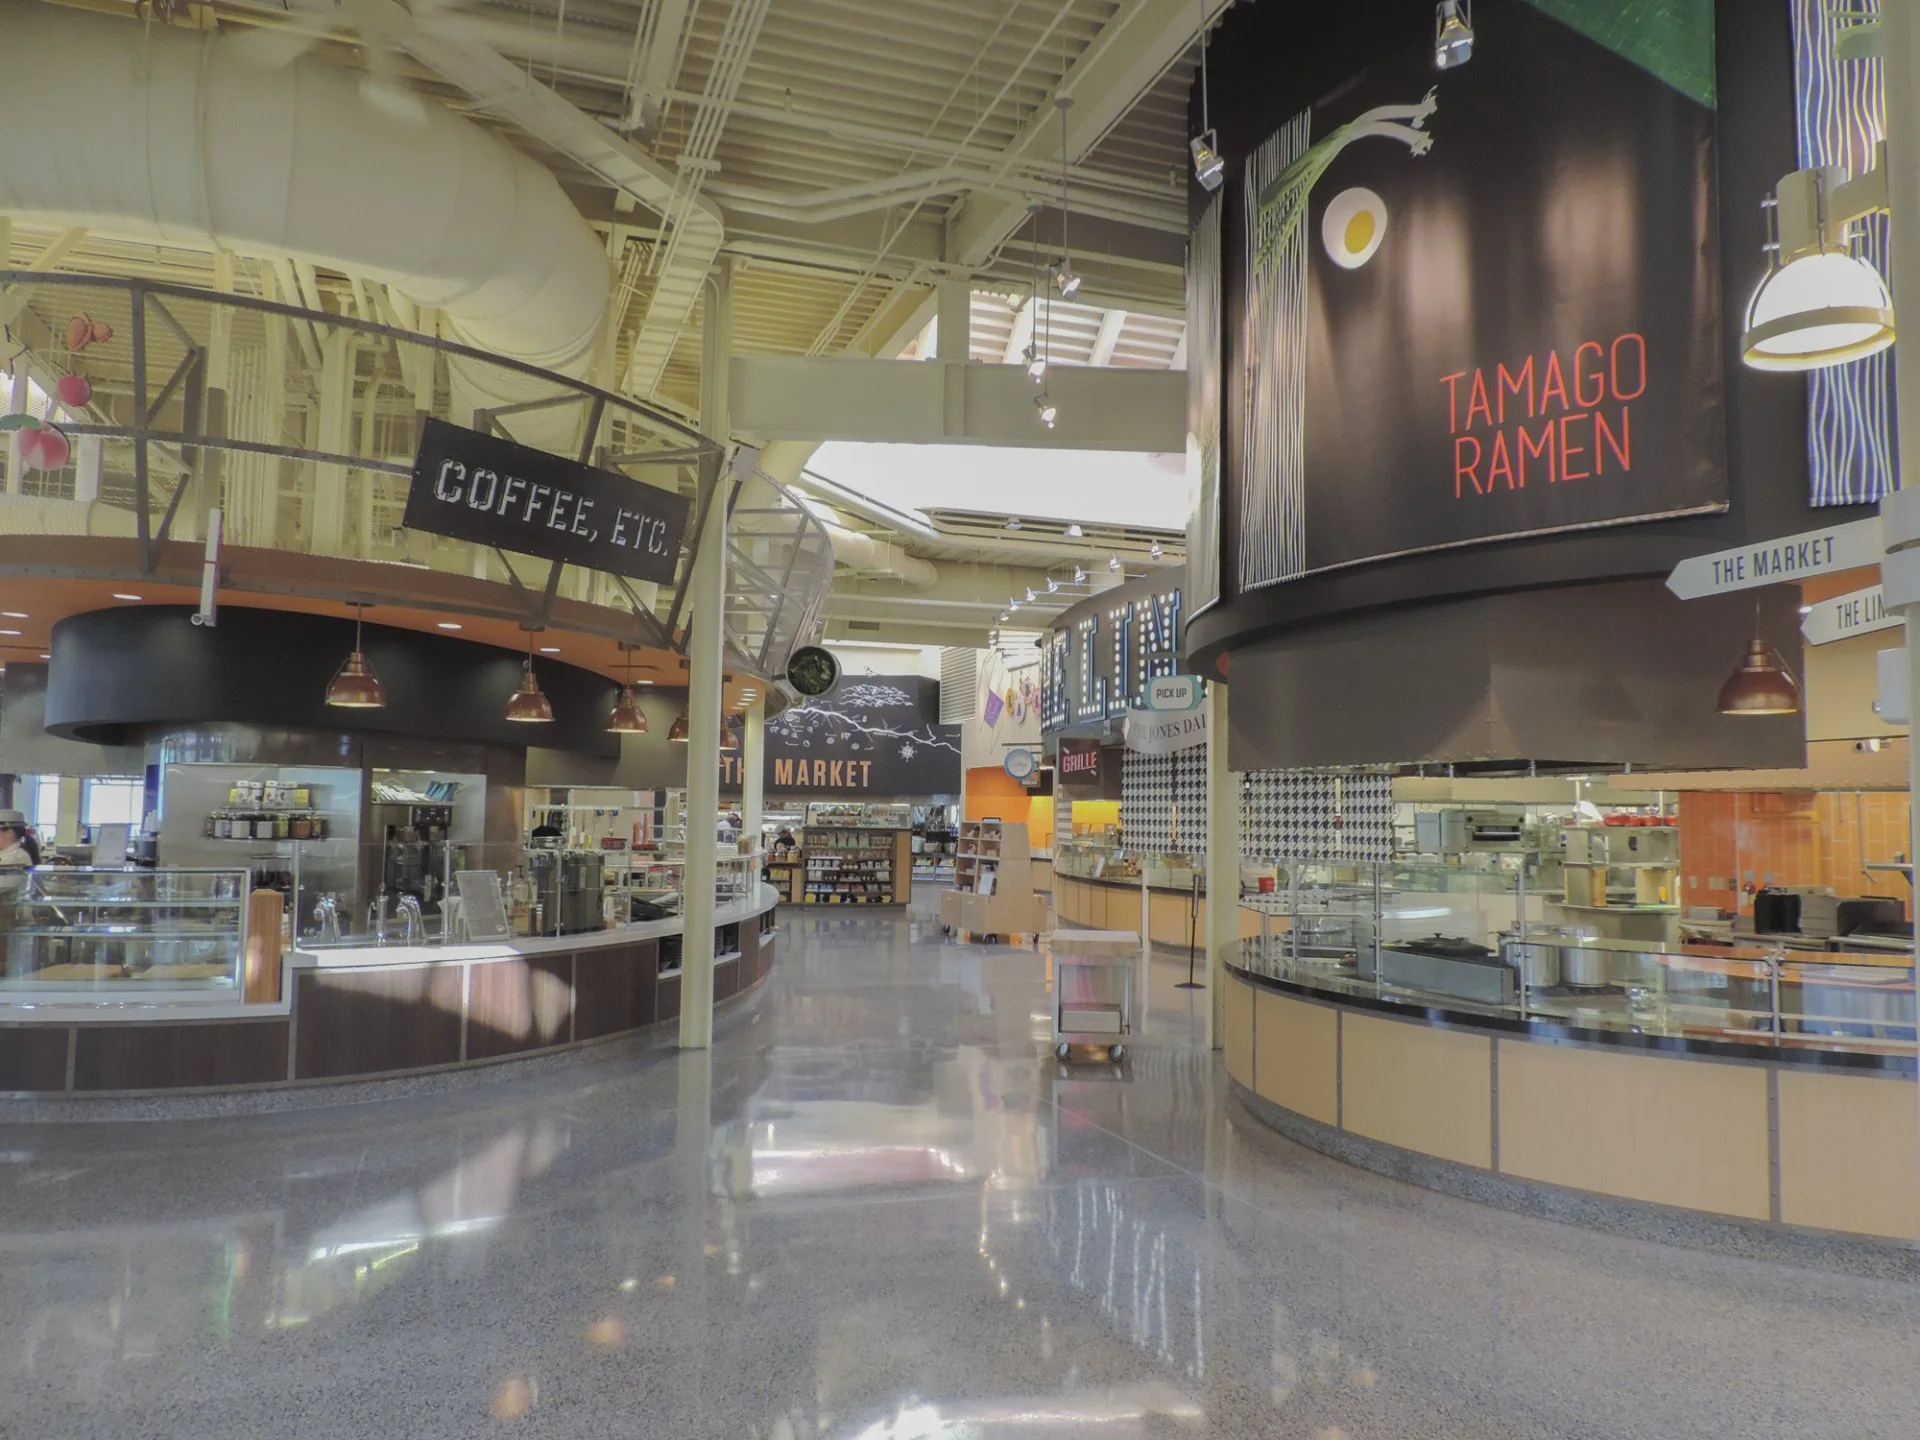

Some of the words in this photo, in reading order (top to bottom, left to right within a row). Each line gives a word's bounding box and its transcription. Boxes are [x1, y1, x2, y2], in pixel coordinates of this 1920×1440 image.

[1439, 332, 1646, 434] TAMAGO
[1455, 405, 1631, 499] RAMEN
[433, 459, 599, 543] COFFEE,
[609, 506, 669, 557] ETC.
[1712, 555, 1746, 586] THE
[1753, 536, 1835, 578] MARKET
[1836, 600, 1860, 630] THE
[1865, 593, 1889, 623] LIN
[1156, 688, 1175, 699] PICK
[1176, 687, 1188, 698] UP
[1148, 721, 1181, 744] JONES
[723, 756, 745, 785] TH
[774, 758, 872, 787] MARKET
[1062, 752, 1097, 773] GRILLE
